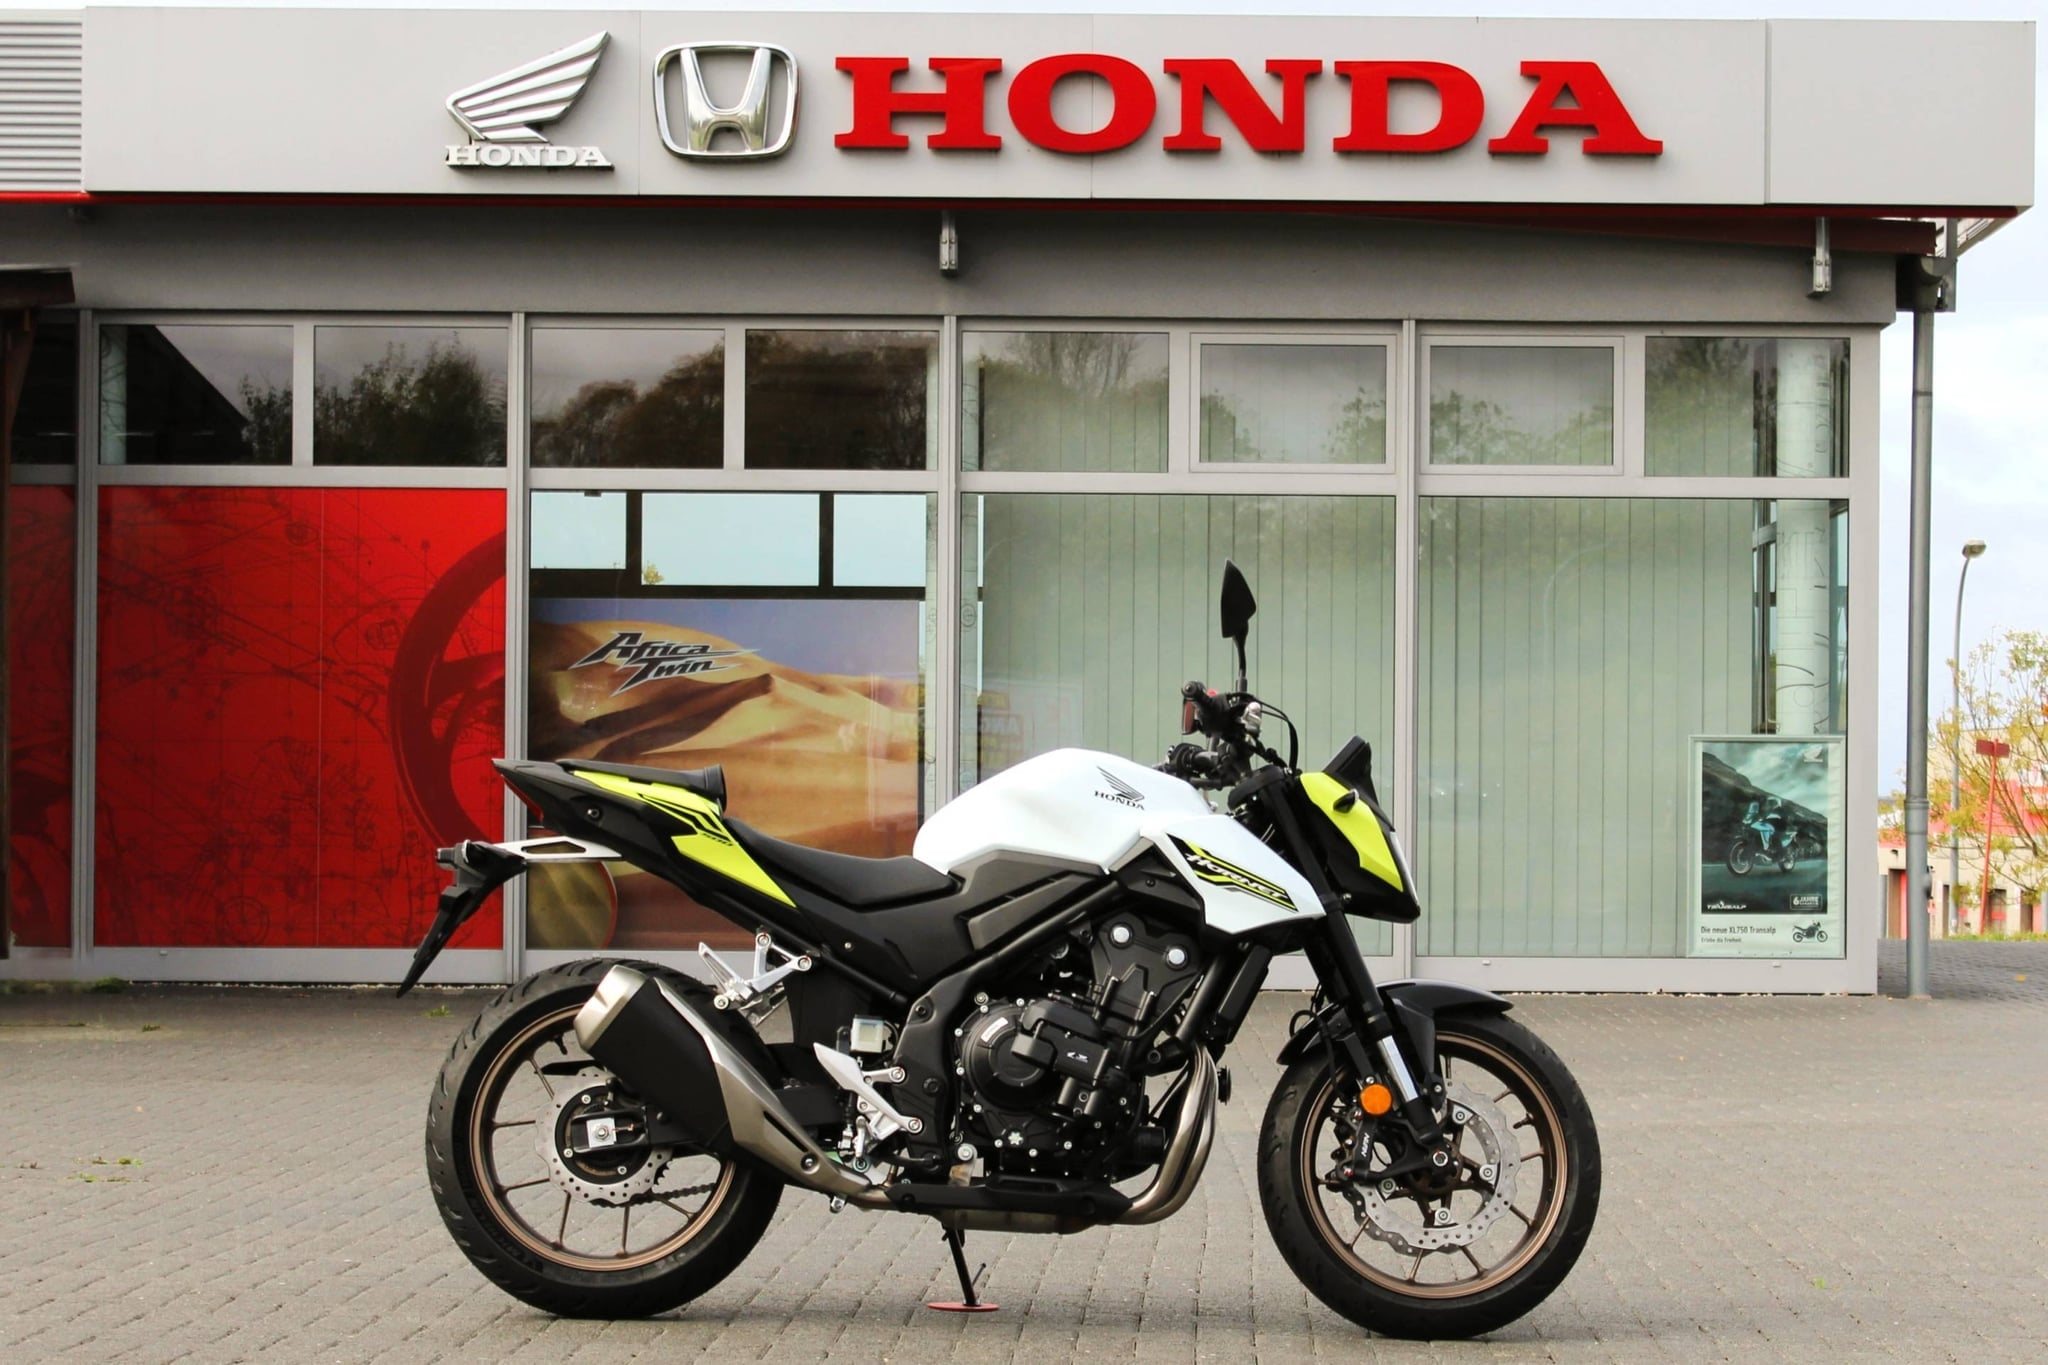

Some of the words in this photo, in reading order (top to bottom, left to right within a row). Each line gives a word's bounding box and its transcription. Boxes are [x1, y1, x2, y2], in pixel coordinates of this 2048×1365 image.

[834, 53, 1664, 156] HONDA
[446, 144, 614, 168] HONDA
[568, 631, 757, 671] Africa
[611, 656, 738, 697] Twin
[1094, 790, 1145, 811] HONDA
[1792, 896, 1800, 906] 6
[1749, 926, 1777, 936] Transalp
